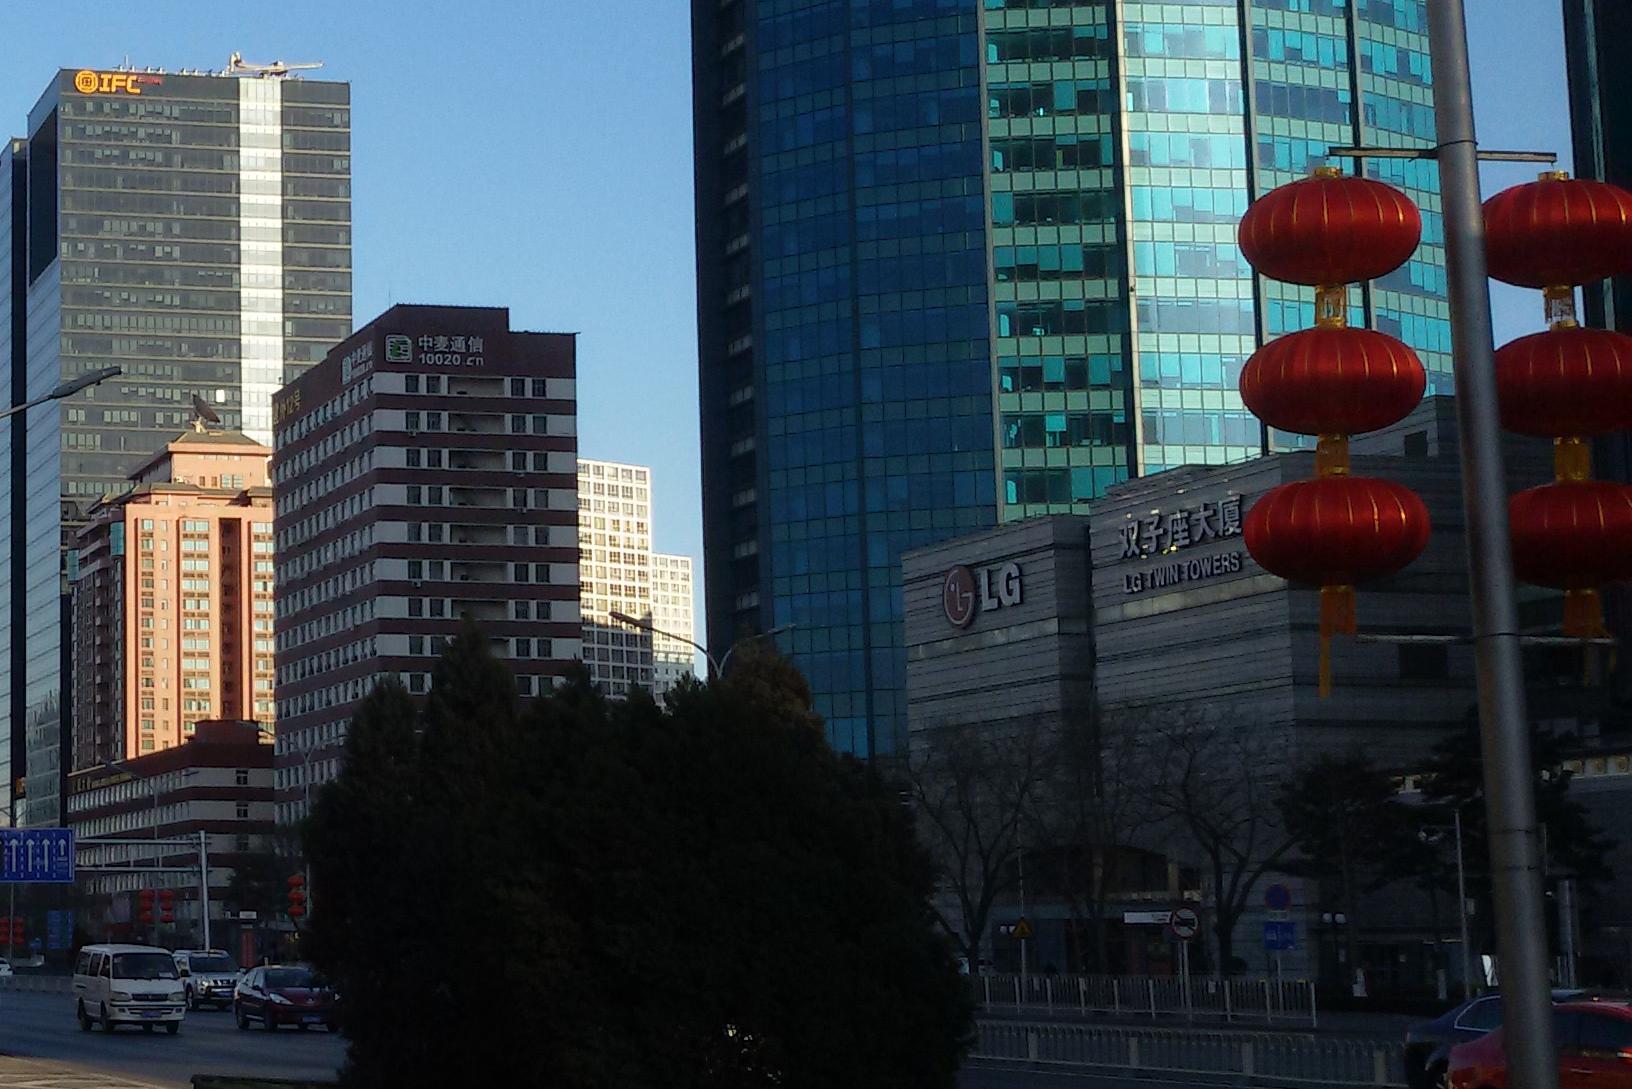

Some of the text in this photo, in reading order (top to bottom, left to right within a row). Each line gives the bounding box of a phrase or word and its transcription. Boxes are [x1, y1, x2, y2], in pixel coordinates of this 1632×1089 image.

[99, 73, 141, 94] IFC
[418, 334, 484, 353] 中麦通信
[1120, 495, 1242, 559] 双子座大厦
[980, 562, 1021, 612] LG
[1123, 551, 1240, 594] LG TWIN TOWERS
